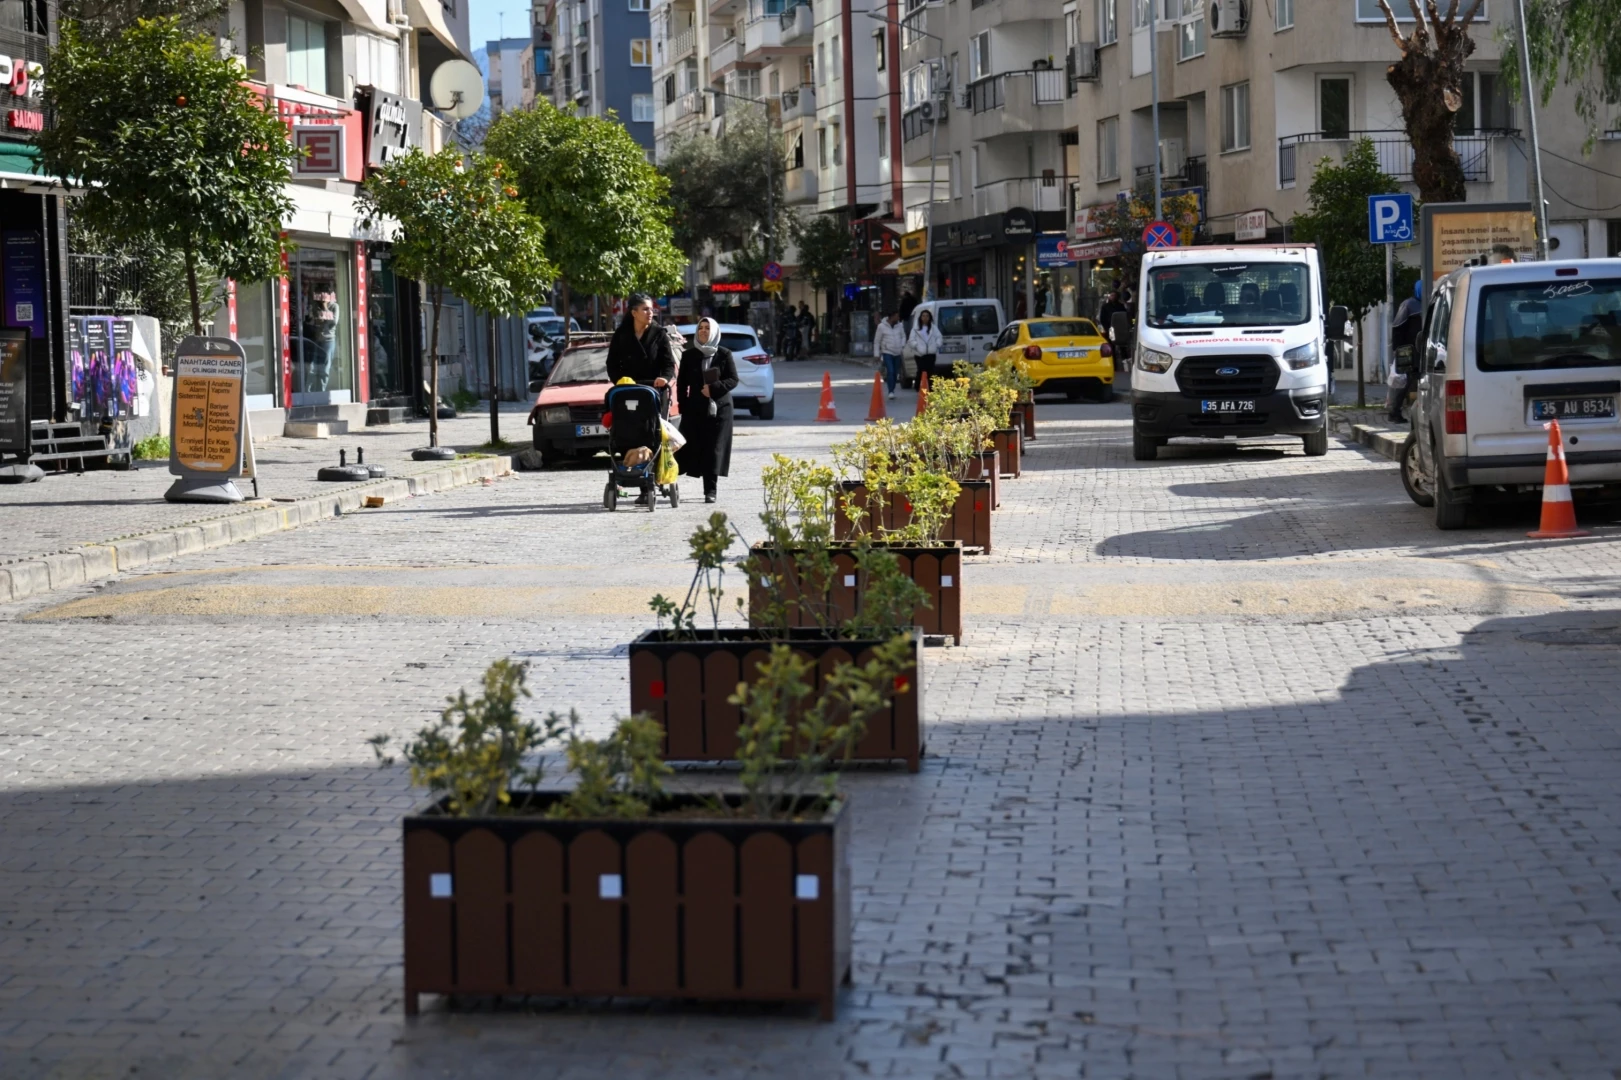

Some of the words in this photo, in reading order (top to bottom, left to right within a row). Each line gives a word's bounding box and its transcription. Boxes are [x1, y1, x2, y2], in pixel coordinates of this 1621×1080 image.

[14, 109, 43, 132] SALONU
[306, 136, 332, 167] E
[1375, 200, 1400, 239] P
[1207, 402, 1217, 410] 35
[1221, 401, 1235, 410] AFA
[1239, 401, 1253, 410] 726
[1542, 402, 1556, 414] 35
[1564, 401, 1577, 413] AU
[1583, 400, 1611, 413] 8534
